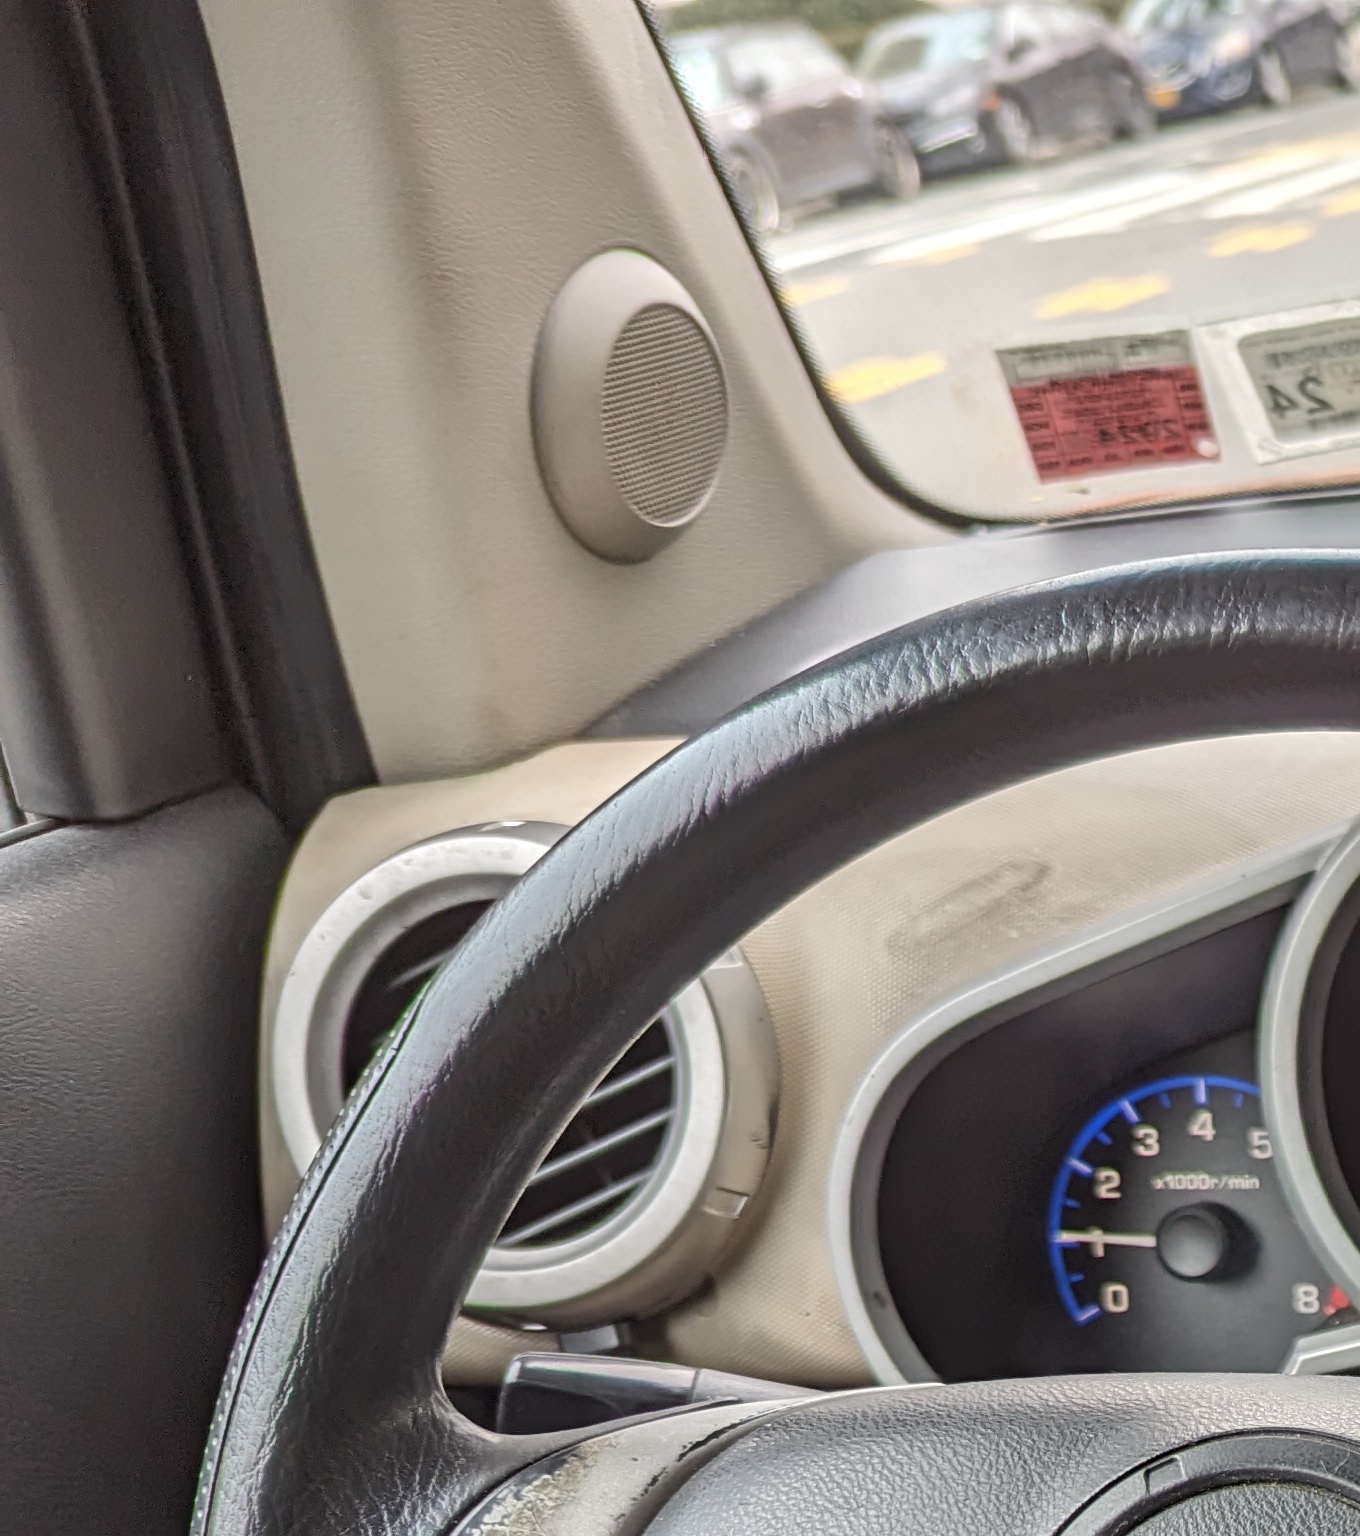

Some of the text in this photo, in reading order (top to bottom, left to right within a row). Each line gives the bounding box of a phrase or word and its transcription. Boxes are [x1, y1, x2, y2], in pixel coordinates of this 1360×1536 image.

[1190, 1112, 1215, 1140] 4
[1135, 1128, 1160, 1156] 3
[1250, 1132, 1272, 1159] 5
[1096, 1170, 1121, 1198] 2
[1106, 1285, 1128, 1312] 0
[1295, 1285, 1320, 1314] 8
